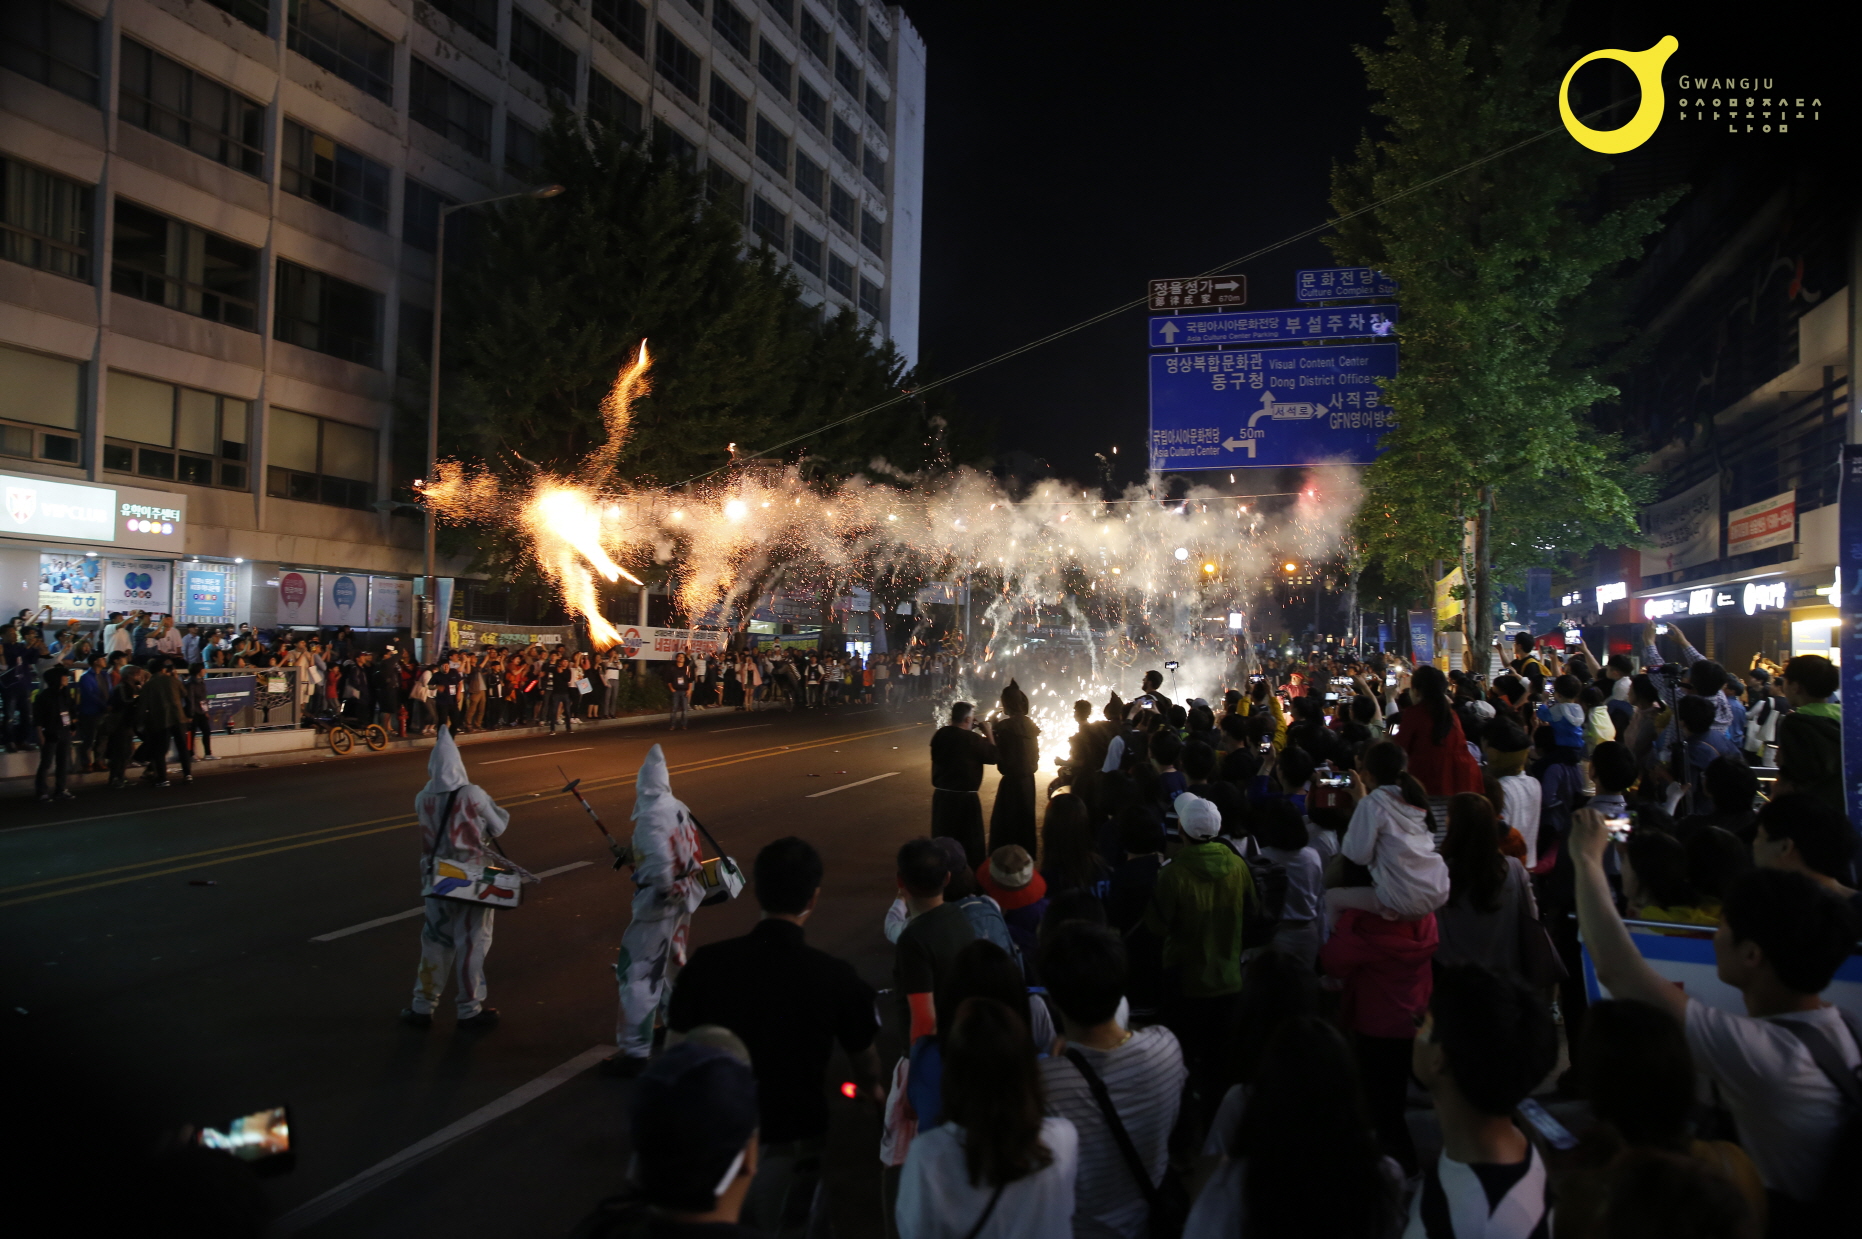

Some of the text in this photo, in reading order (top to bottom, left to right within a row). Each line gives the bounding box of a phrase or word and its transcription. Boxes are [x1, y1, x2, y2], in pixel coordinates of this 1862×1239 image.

[1154, 280, 1213, 297] 정율성가
[1301, 288, 1332, 297] Culture
[1336, 286, 1374, 296] Complex
[1186, 312, 1387, 334] 국립아시아문화전당 부설주차장
[1203, 334, 1227, 342] Culture
[1228, 332, 1251, 340] Center
[1166, 353, 1369, 374] 영상복합문화관 Visual Content Center
[1211, 372, 1370, 391] 동구청 Dong District Office
[1328, 391, 1394, 409] 사적공
[1275, 406, 1309, 416] 서석로
[1153, 427, 1220, 446] 국립아시아문화전당
[1240, 428, 1265, 439] 50m
[1169, 446, 1196, 457] Culture
[1196, 445, 1220, 456] Center
[120, 502, 181, 522] 유학이주센터
